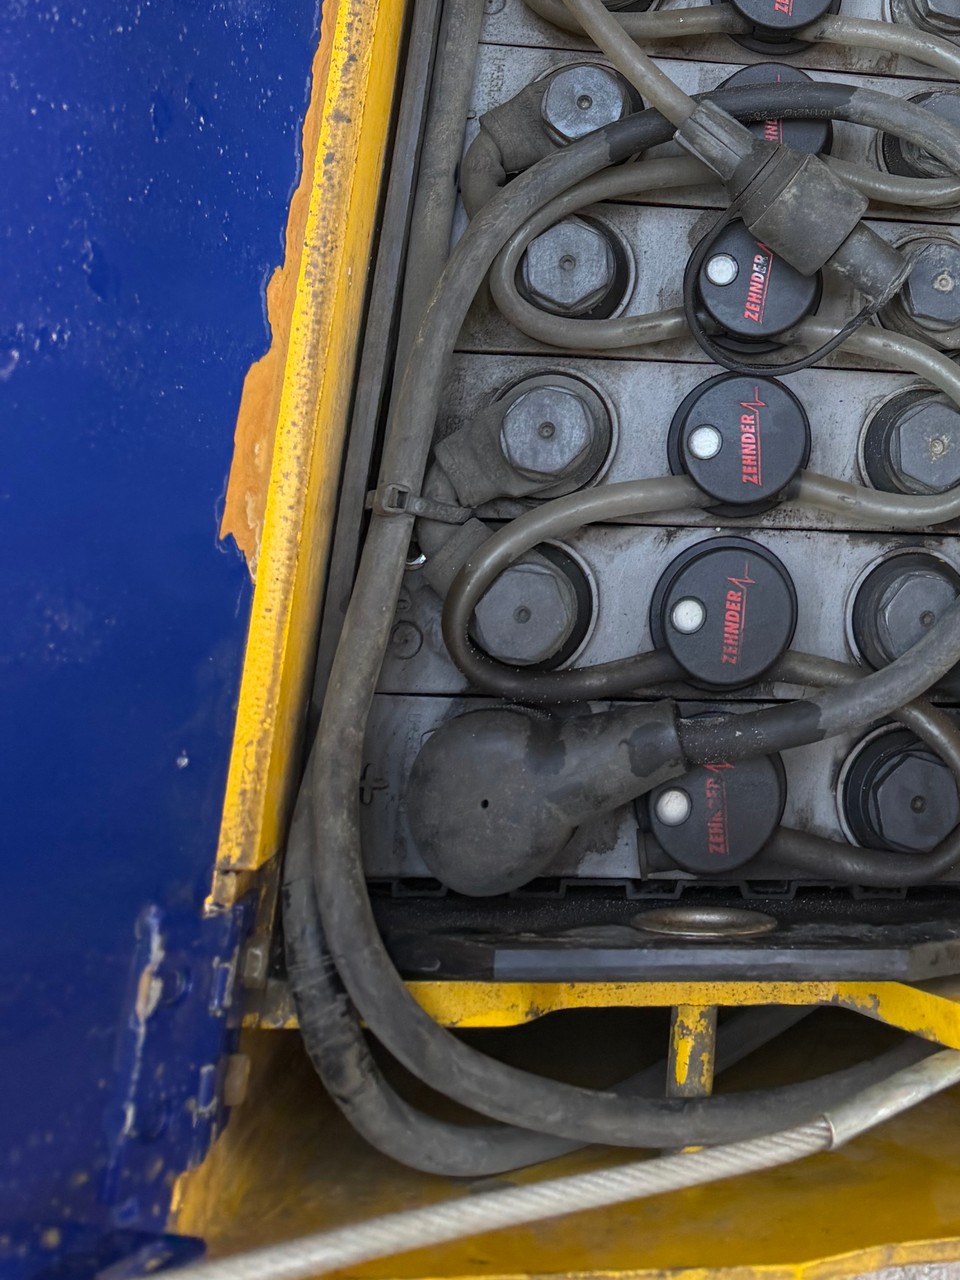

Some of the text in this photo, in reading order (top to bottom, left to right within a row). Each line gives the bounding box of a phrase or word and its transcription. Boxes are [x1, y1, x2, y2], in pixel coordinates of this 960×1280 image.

[743, 254, 769, 322] ZEHNDER
[740, 414, 758, 485] ZEHNDER
[721, 590, 743, 665] ZEHNDER
